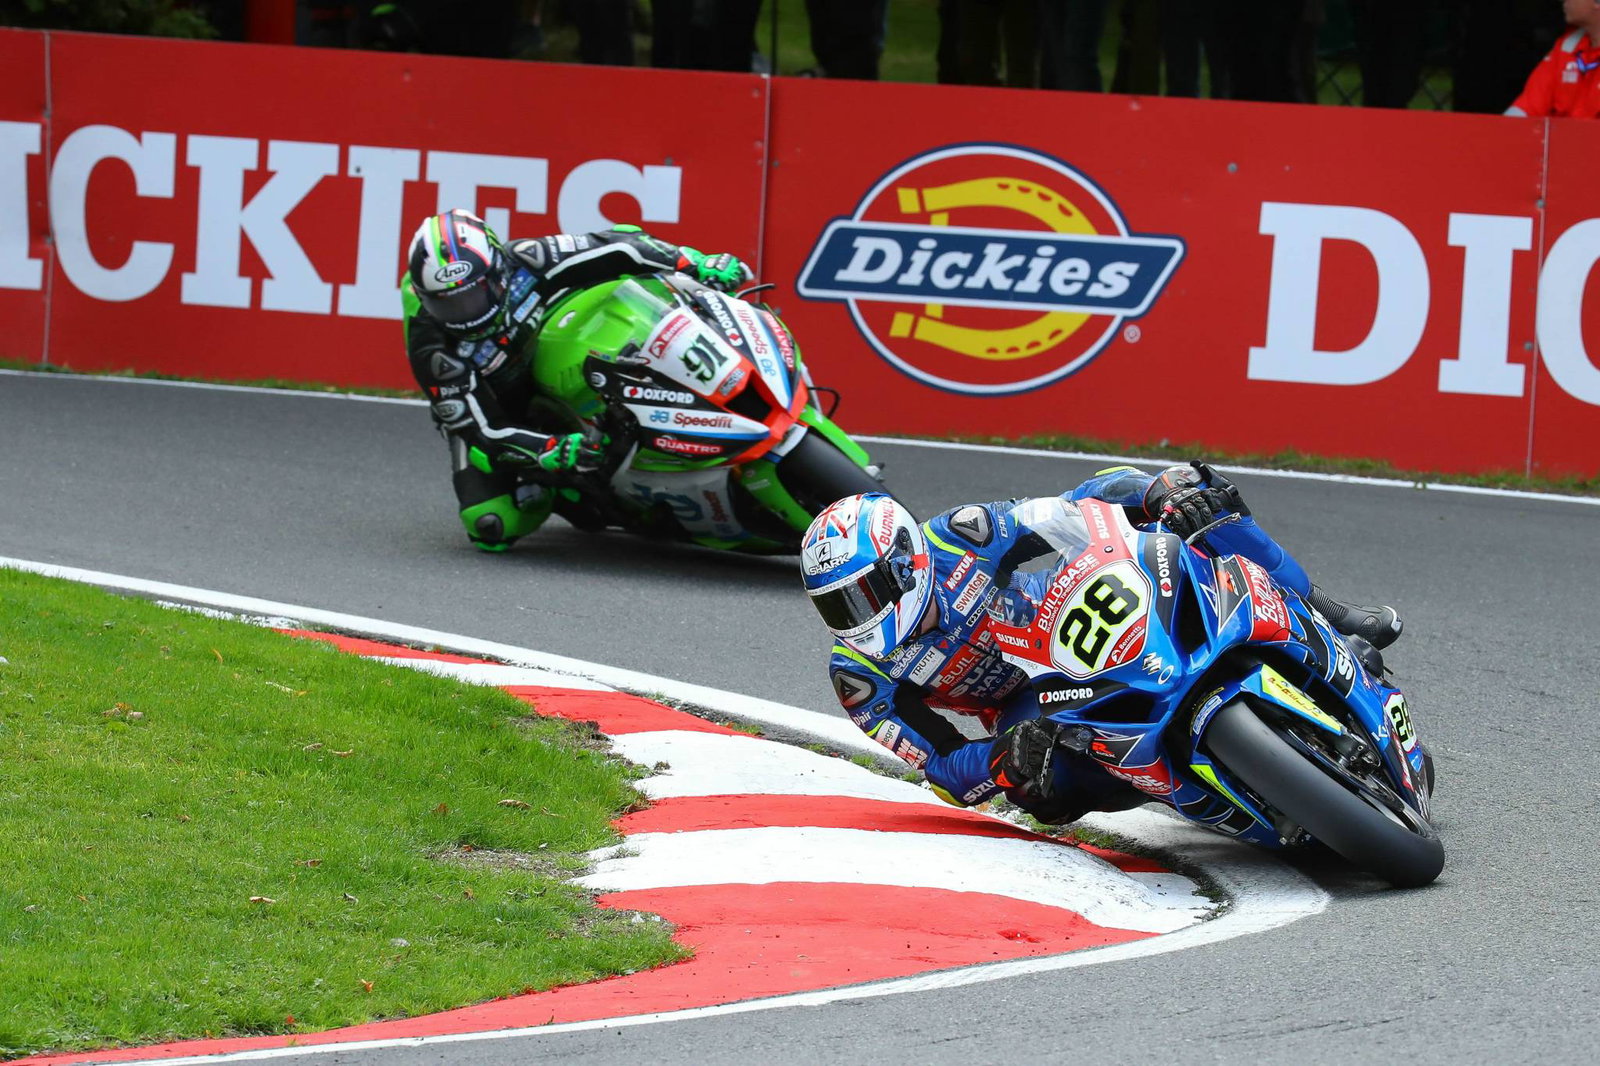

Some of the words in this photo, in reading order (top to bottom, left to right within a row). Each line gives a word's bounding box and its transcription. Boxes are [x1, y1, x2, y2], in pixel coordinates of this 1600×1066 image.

[440, 263, 467, 279] Arai
[835, 235, 1139, 300] Dickies
[703, 290, 735, 329] OXFORD
[737, 309, 768, 355] Speedfit
[678, 333, 729, 385] 91
[643, 387, 695, 404] OXFORD
[673, 412, 733, 429] Speedfit
[656, 437, 721, 454] QUATTRO
[808, 553, 851, 576] SHARK
[946, 555, 975, 590] MOTUL
[1155, 537, 1170, 579] OXFORD
[955, 573, 987, 612] swinton
[1036, 553, 1099, 632] BUILDBASE
[1059, 573, 1140, 671] 28
[1118, 625, 1143, 651] Bennetts
[996, 633, 1030, 649] SUZUKI
[892, 645, 921, 677] SHARK
[912, 651, 935, 676] TRUTH
[1051, 687, 1093, 701] OXFORD
